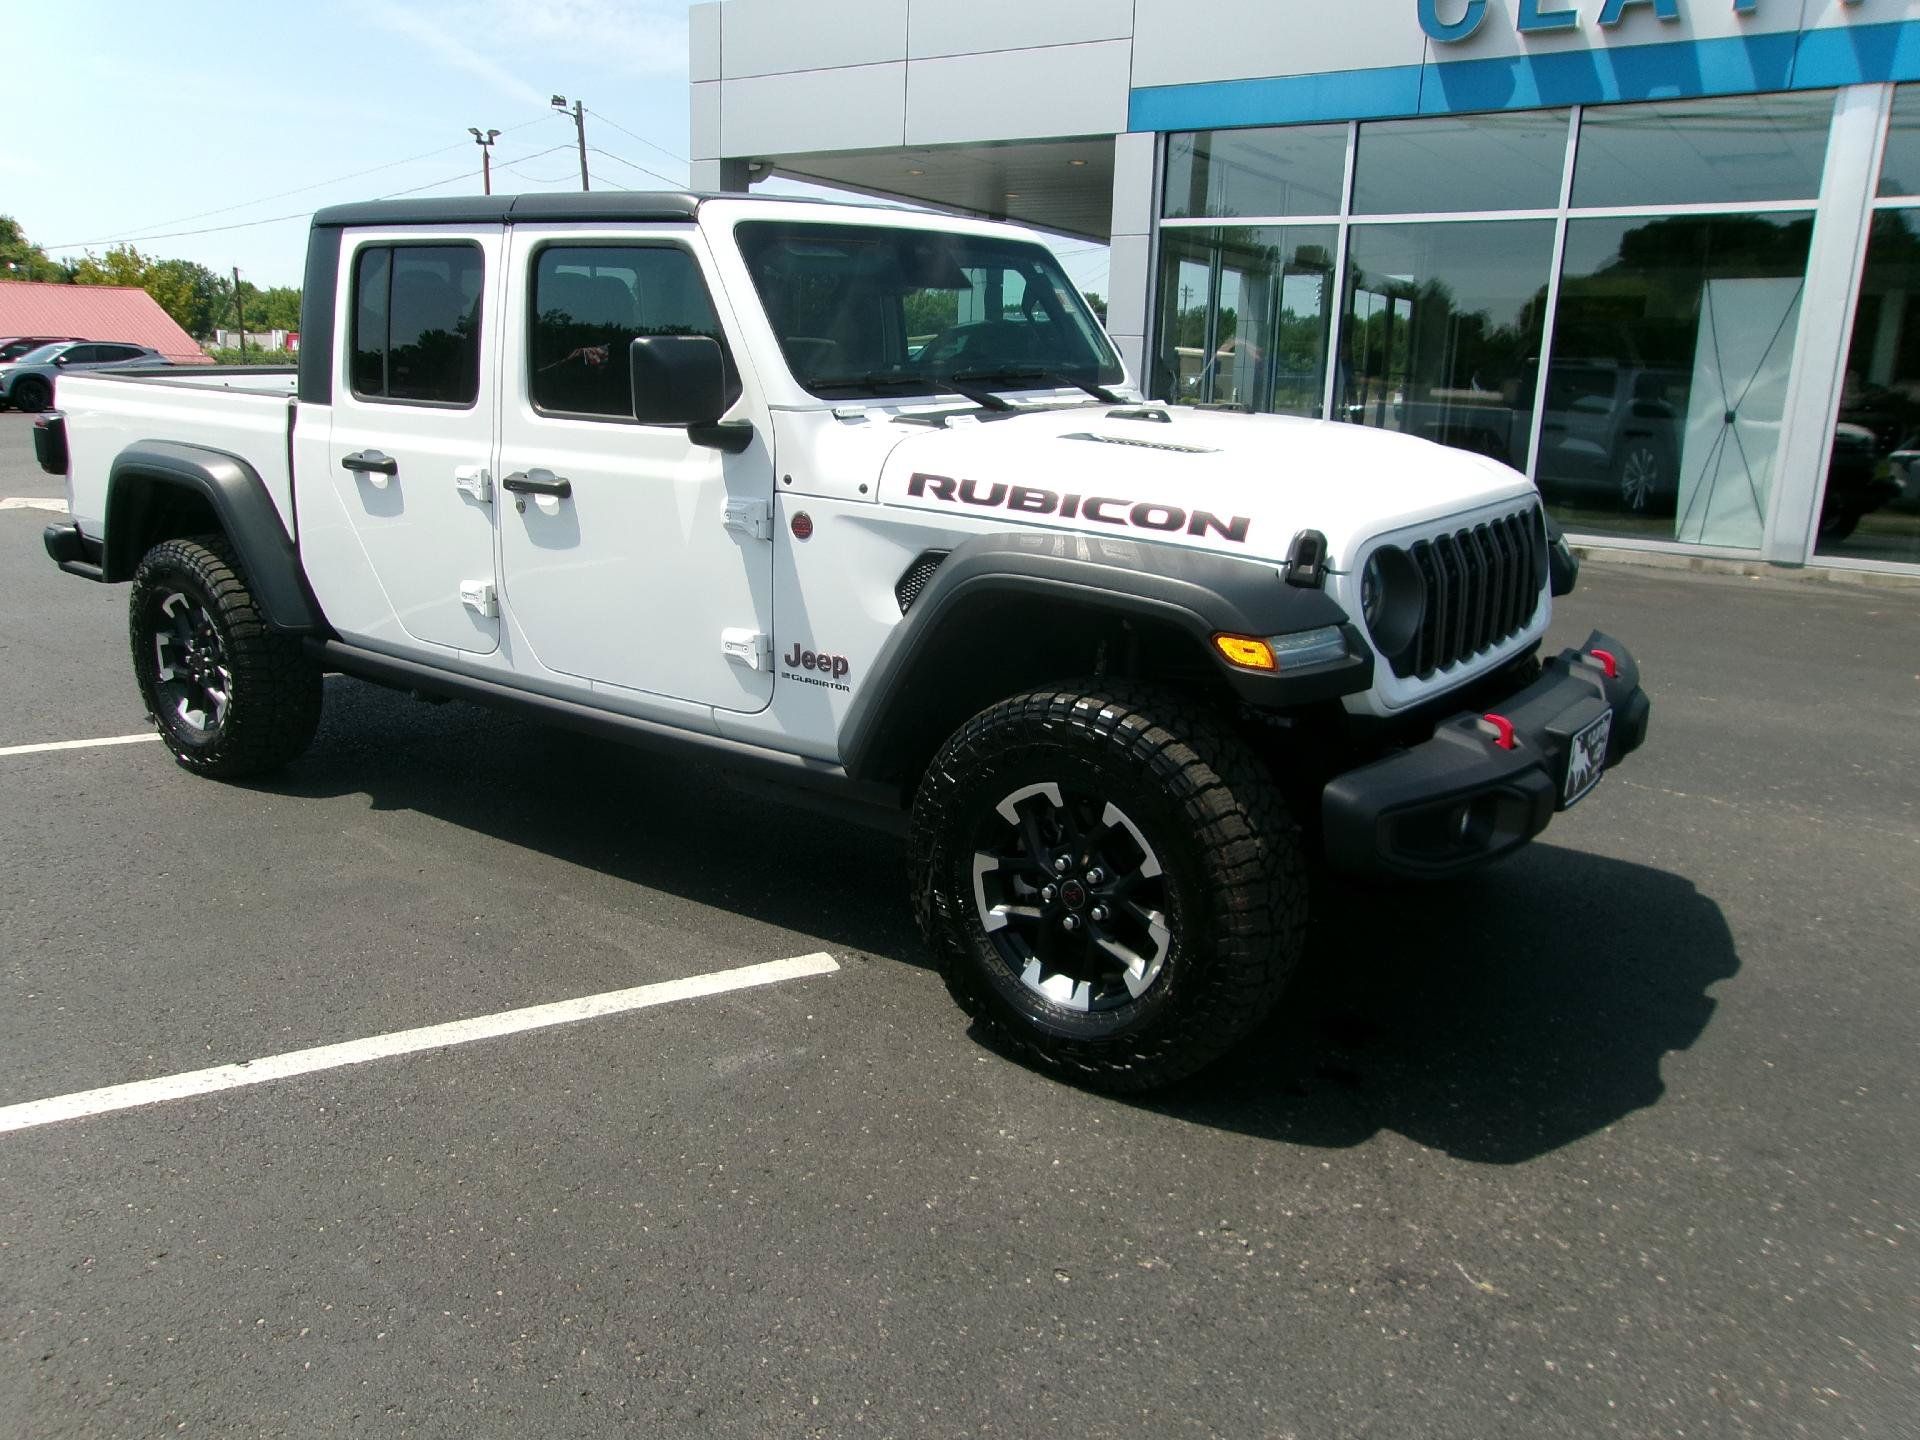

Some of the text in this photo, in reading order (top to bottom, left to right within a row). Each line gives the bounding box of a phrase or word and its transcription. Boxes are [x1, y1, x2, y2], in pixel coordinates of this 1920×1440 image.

[907, 472, 1251, 543] RUBICON
[784, 642, 849, 679] Jeep
[791, 674, 850, 693] GLADIATOR
